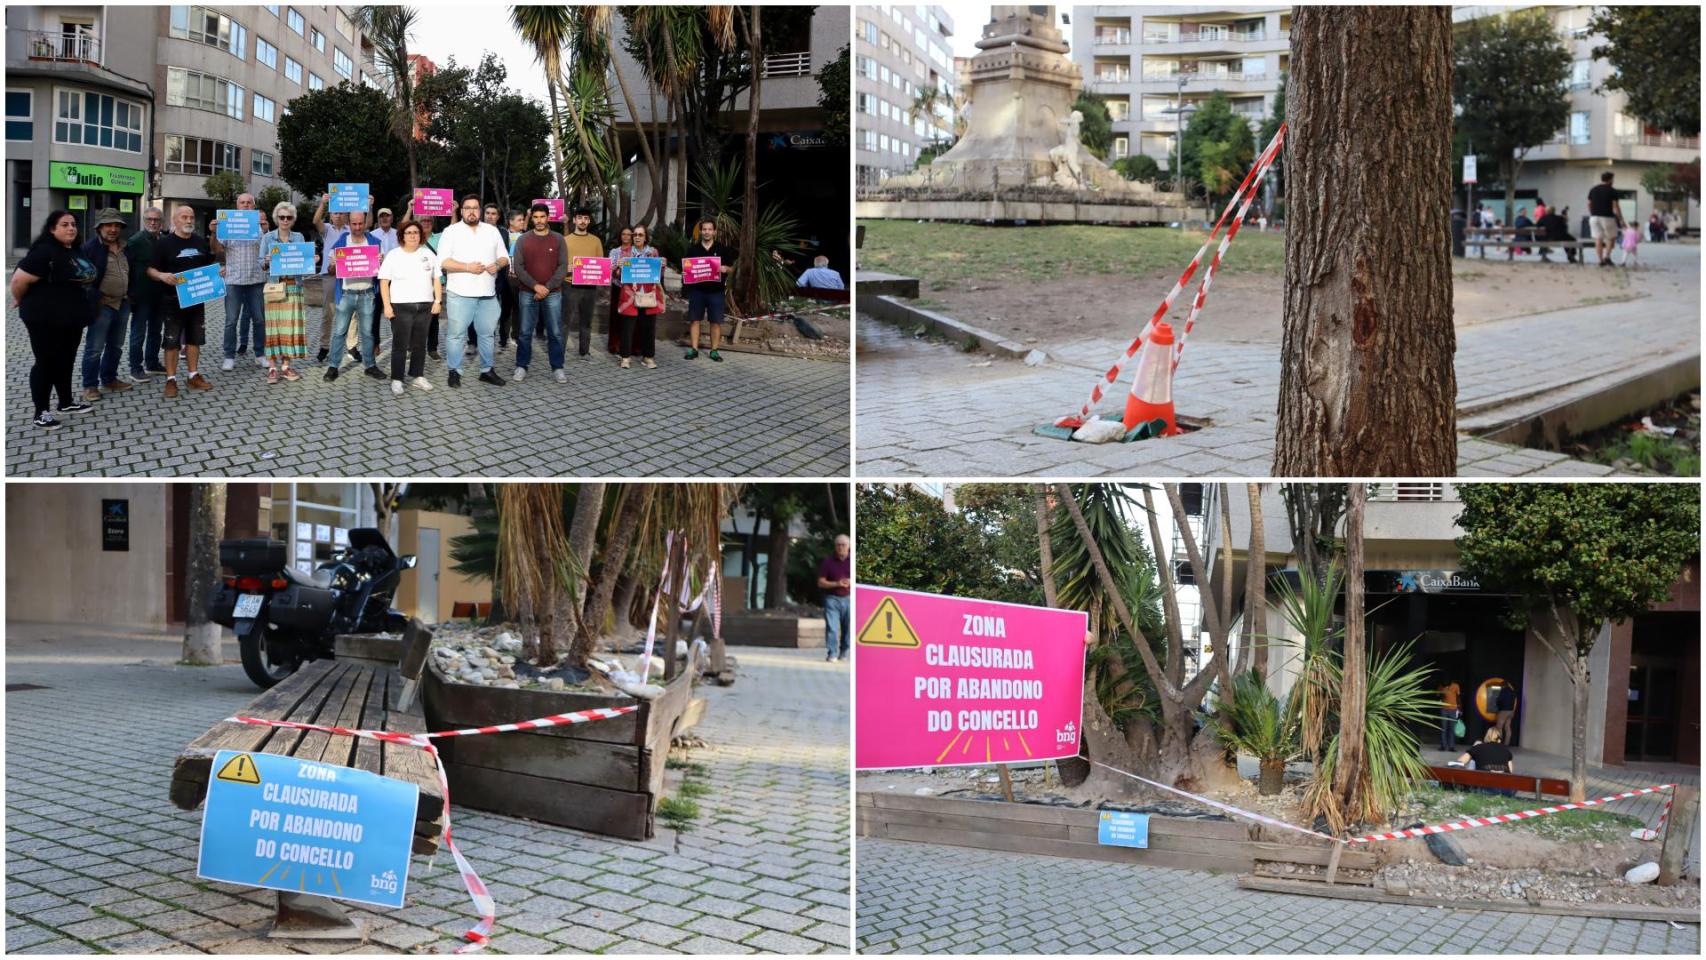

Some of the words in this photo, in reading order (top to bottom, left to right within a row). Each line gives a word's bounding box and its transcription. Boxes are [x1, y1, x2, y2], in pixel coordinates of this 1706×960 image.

[67, 166, 77, 176] 25
[76, 173, 104, 187] Julio
[962, 613, 1007, 638] ZONA
[925, 643, 1034, 670] CLAUSURADA
[914, 676, 951, 699] POR
[957, 677, 1043, 700] ABANDONO
[927, 710, 952, 732] DO
[957, 709, 1038, 732] CONCELLO
[1056, 728, 1077, 745] bng
[297, 763, 336, 782] ZONA
[263, 783, 358, 813] CLAUSURADA
[250, 809, 279, 831] POR
[283, 814, 363, 843] ABANDONO
[256, 839, 276, 859] DO
[280, 843, 354, 870] CONCELLO
[370, 874, 399, 896] bng
